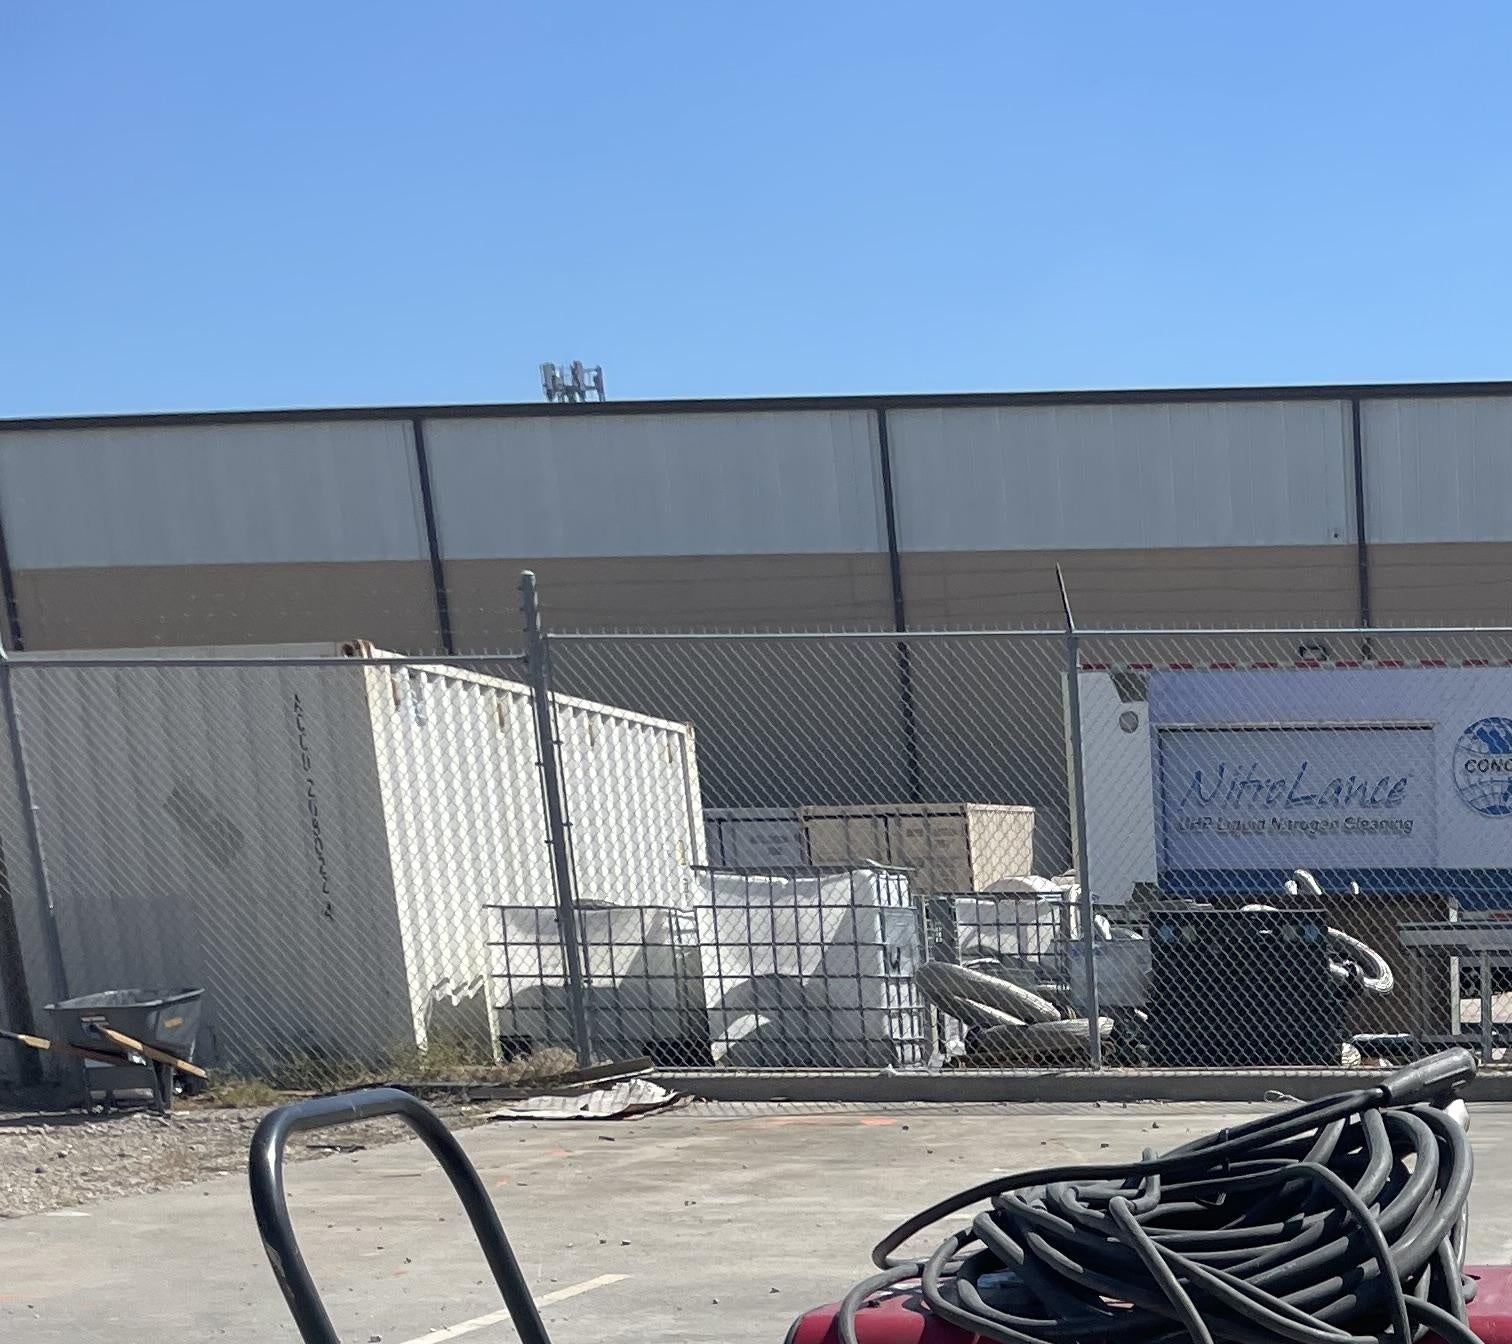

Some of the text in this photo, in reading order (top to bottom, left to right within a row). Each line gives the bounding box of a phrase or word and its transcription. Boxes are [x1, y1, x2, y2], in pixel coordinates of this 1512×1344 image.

[1179, 761, 1408, 808] NitroLance
[1216, 815, 1266, 834] Liquid
[1271, 816, 1340, 836] Nitrogen
[1344, 815, 1414, 834] Cleaning
